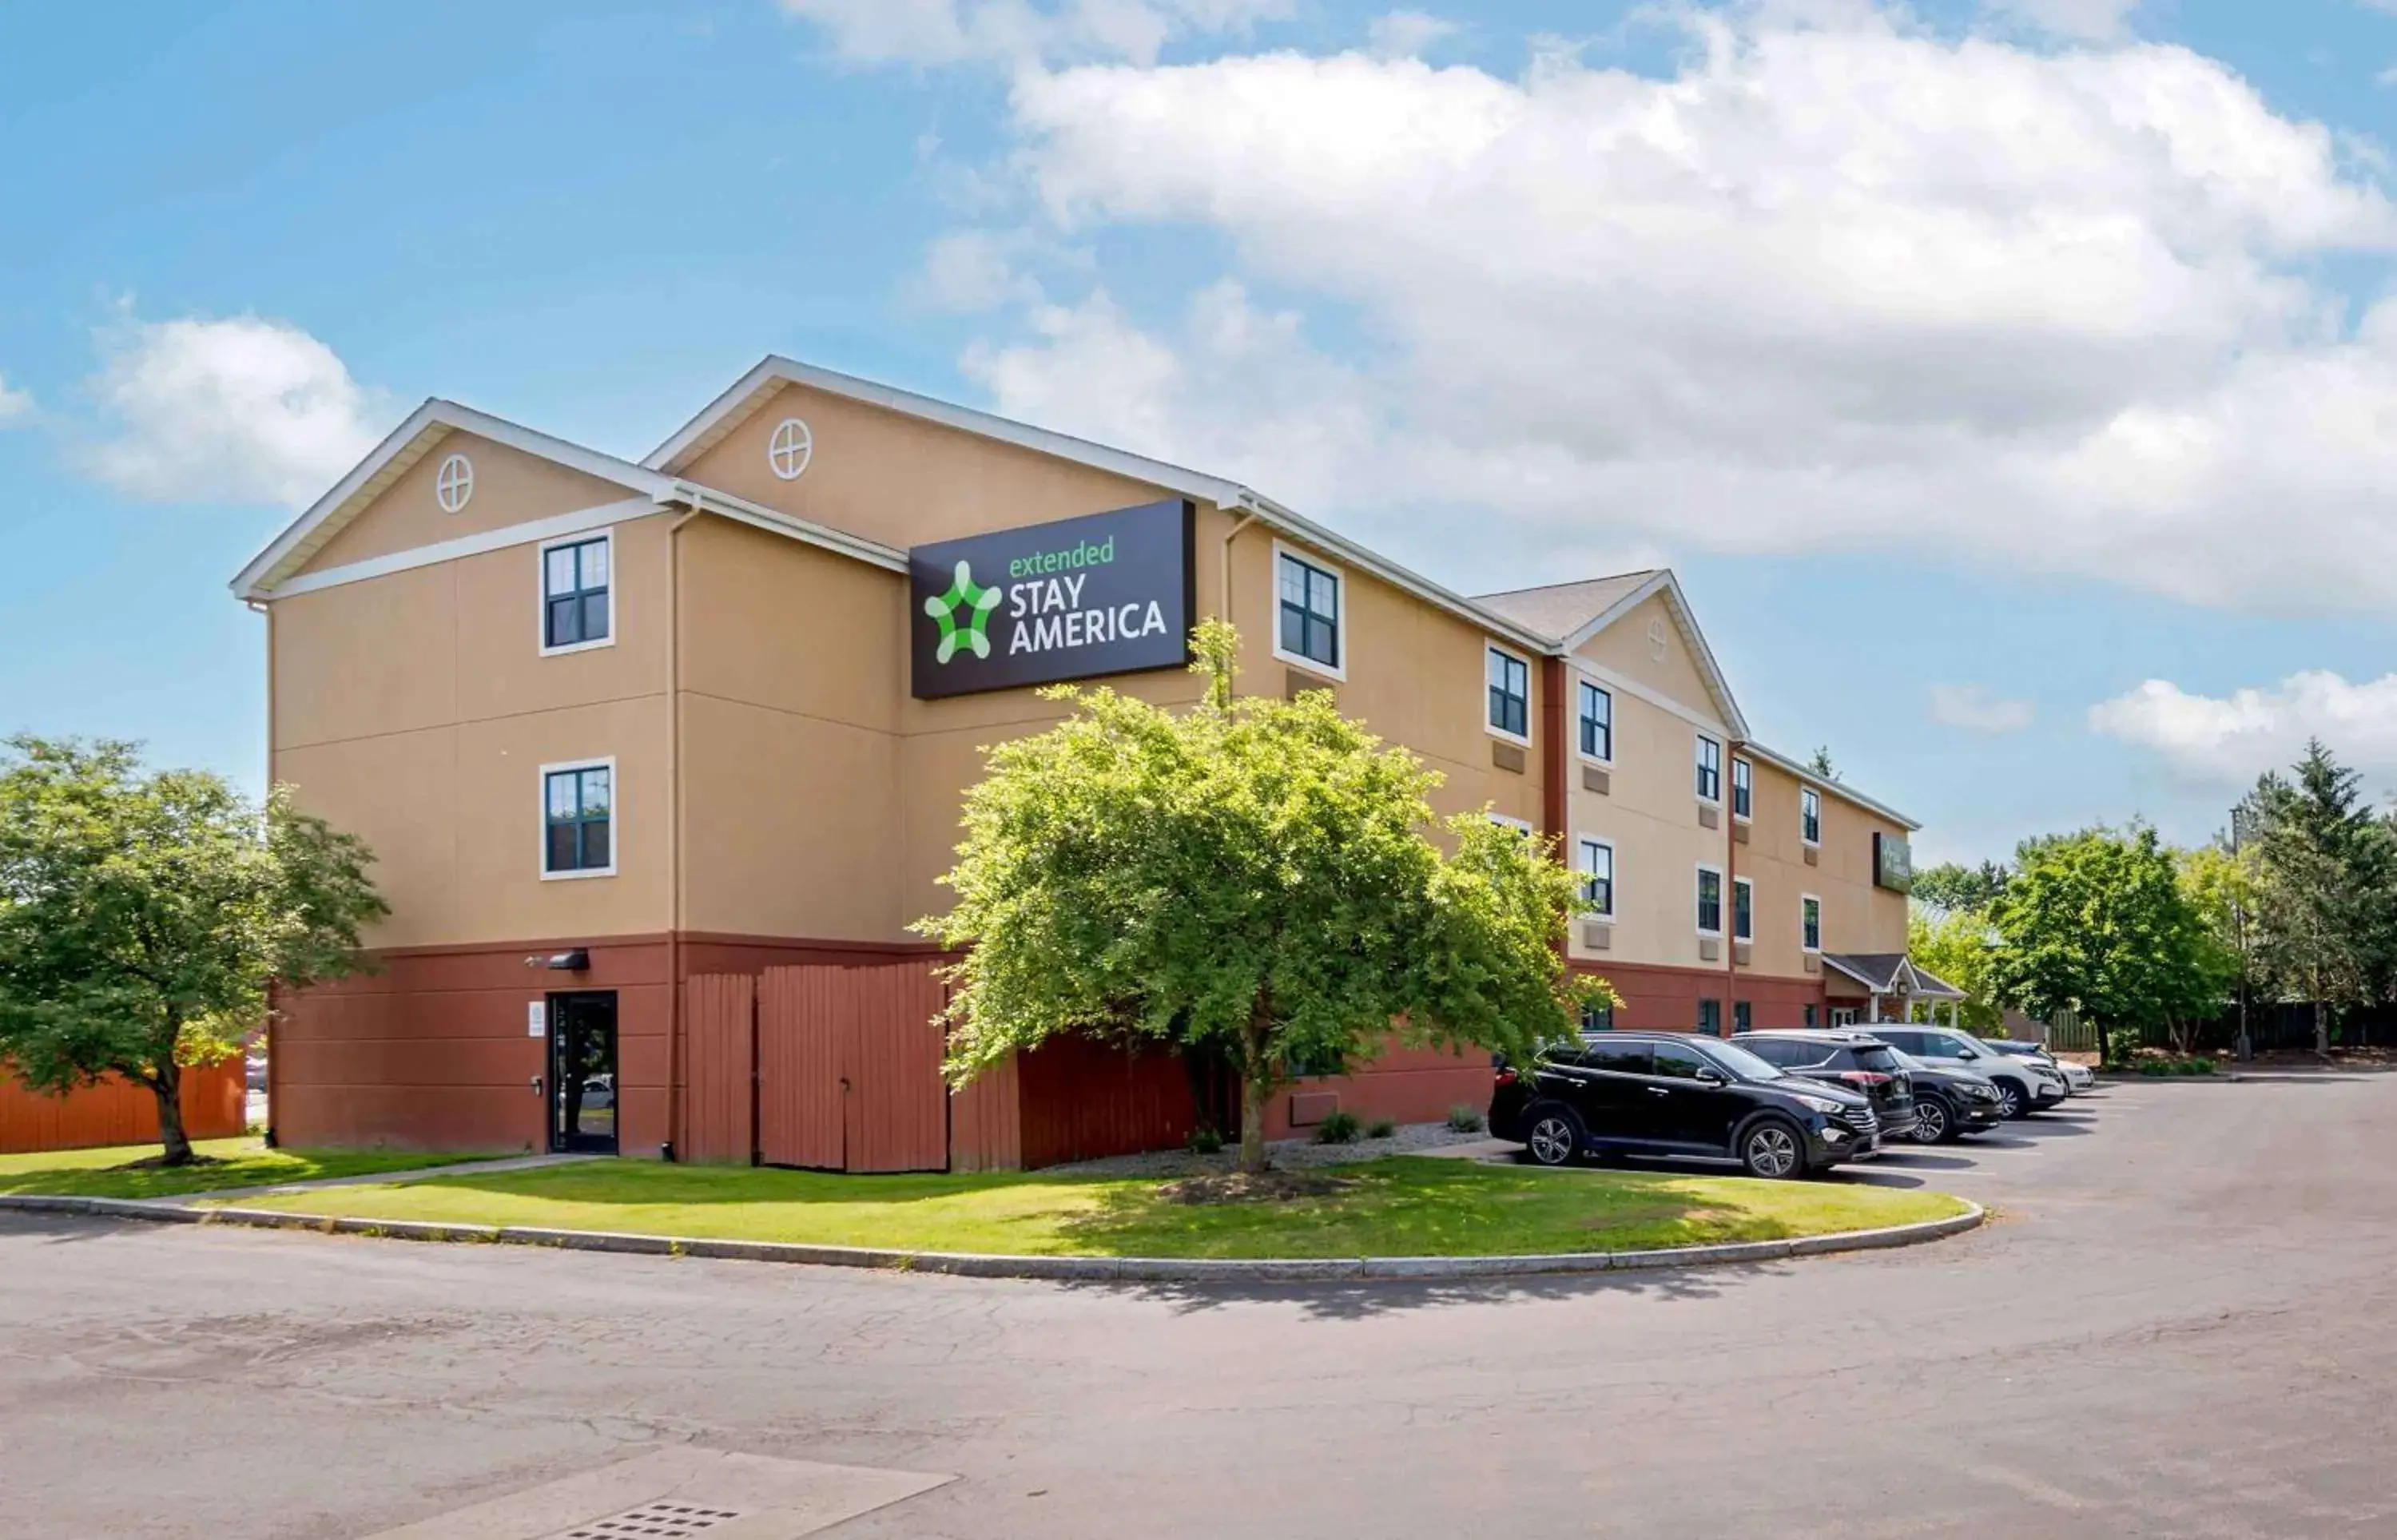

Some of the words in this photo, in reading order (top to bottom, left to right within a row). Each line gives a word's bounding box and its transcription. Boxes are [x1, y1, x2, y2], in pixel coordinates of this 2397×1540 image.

[1010, 534, 1114, 578] extended
[1010, 573, 1086, 617] STAY
[1009, 600, 1167, 655] AMERICA
